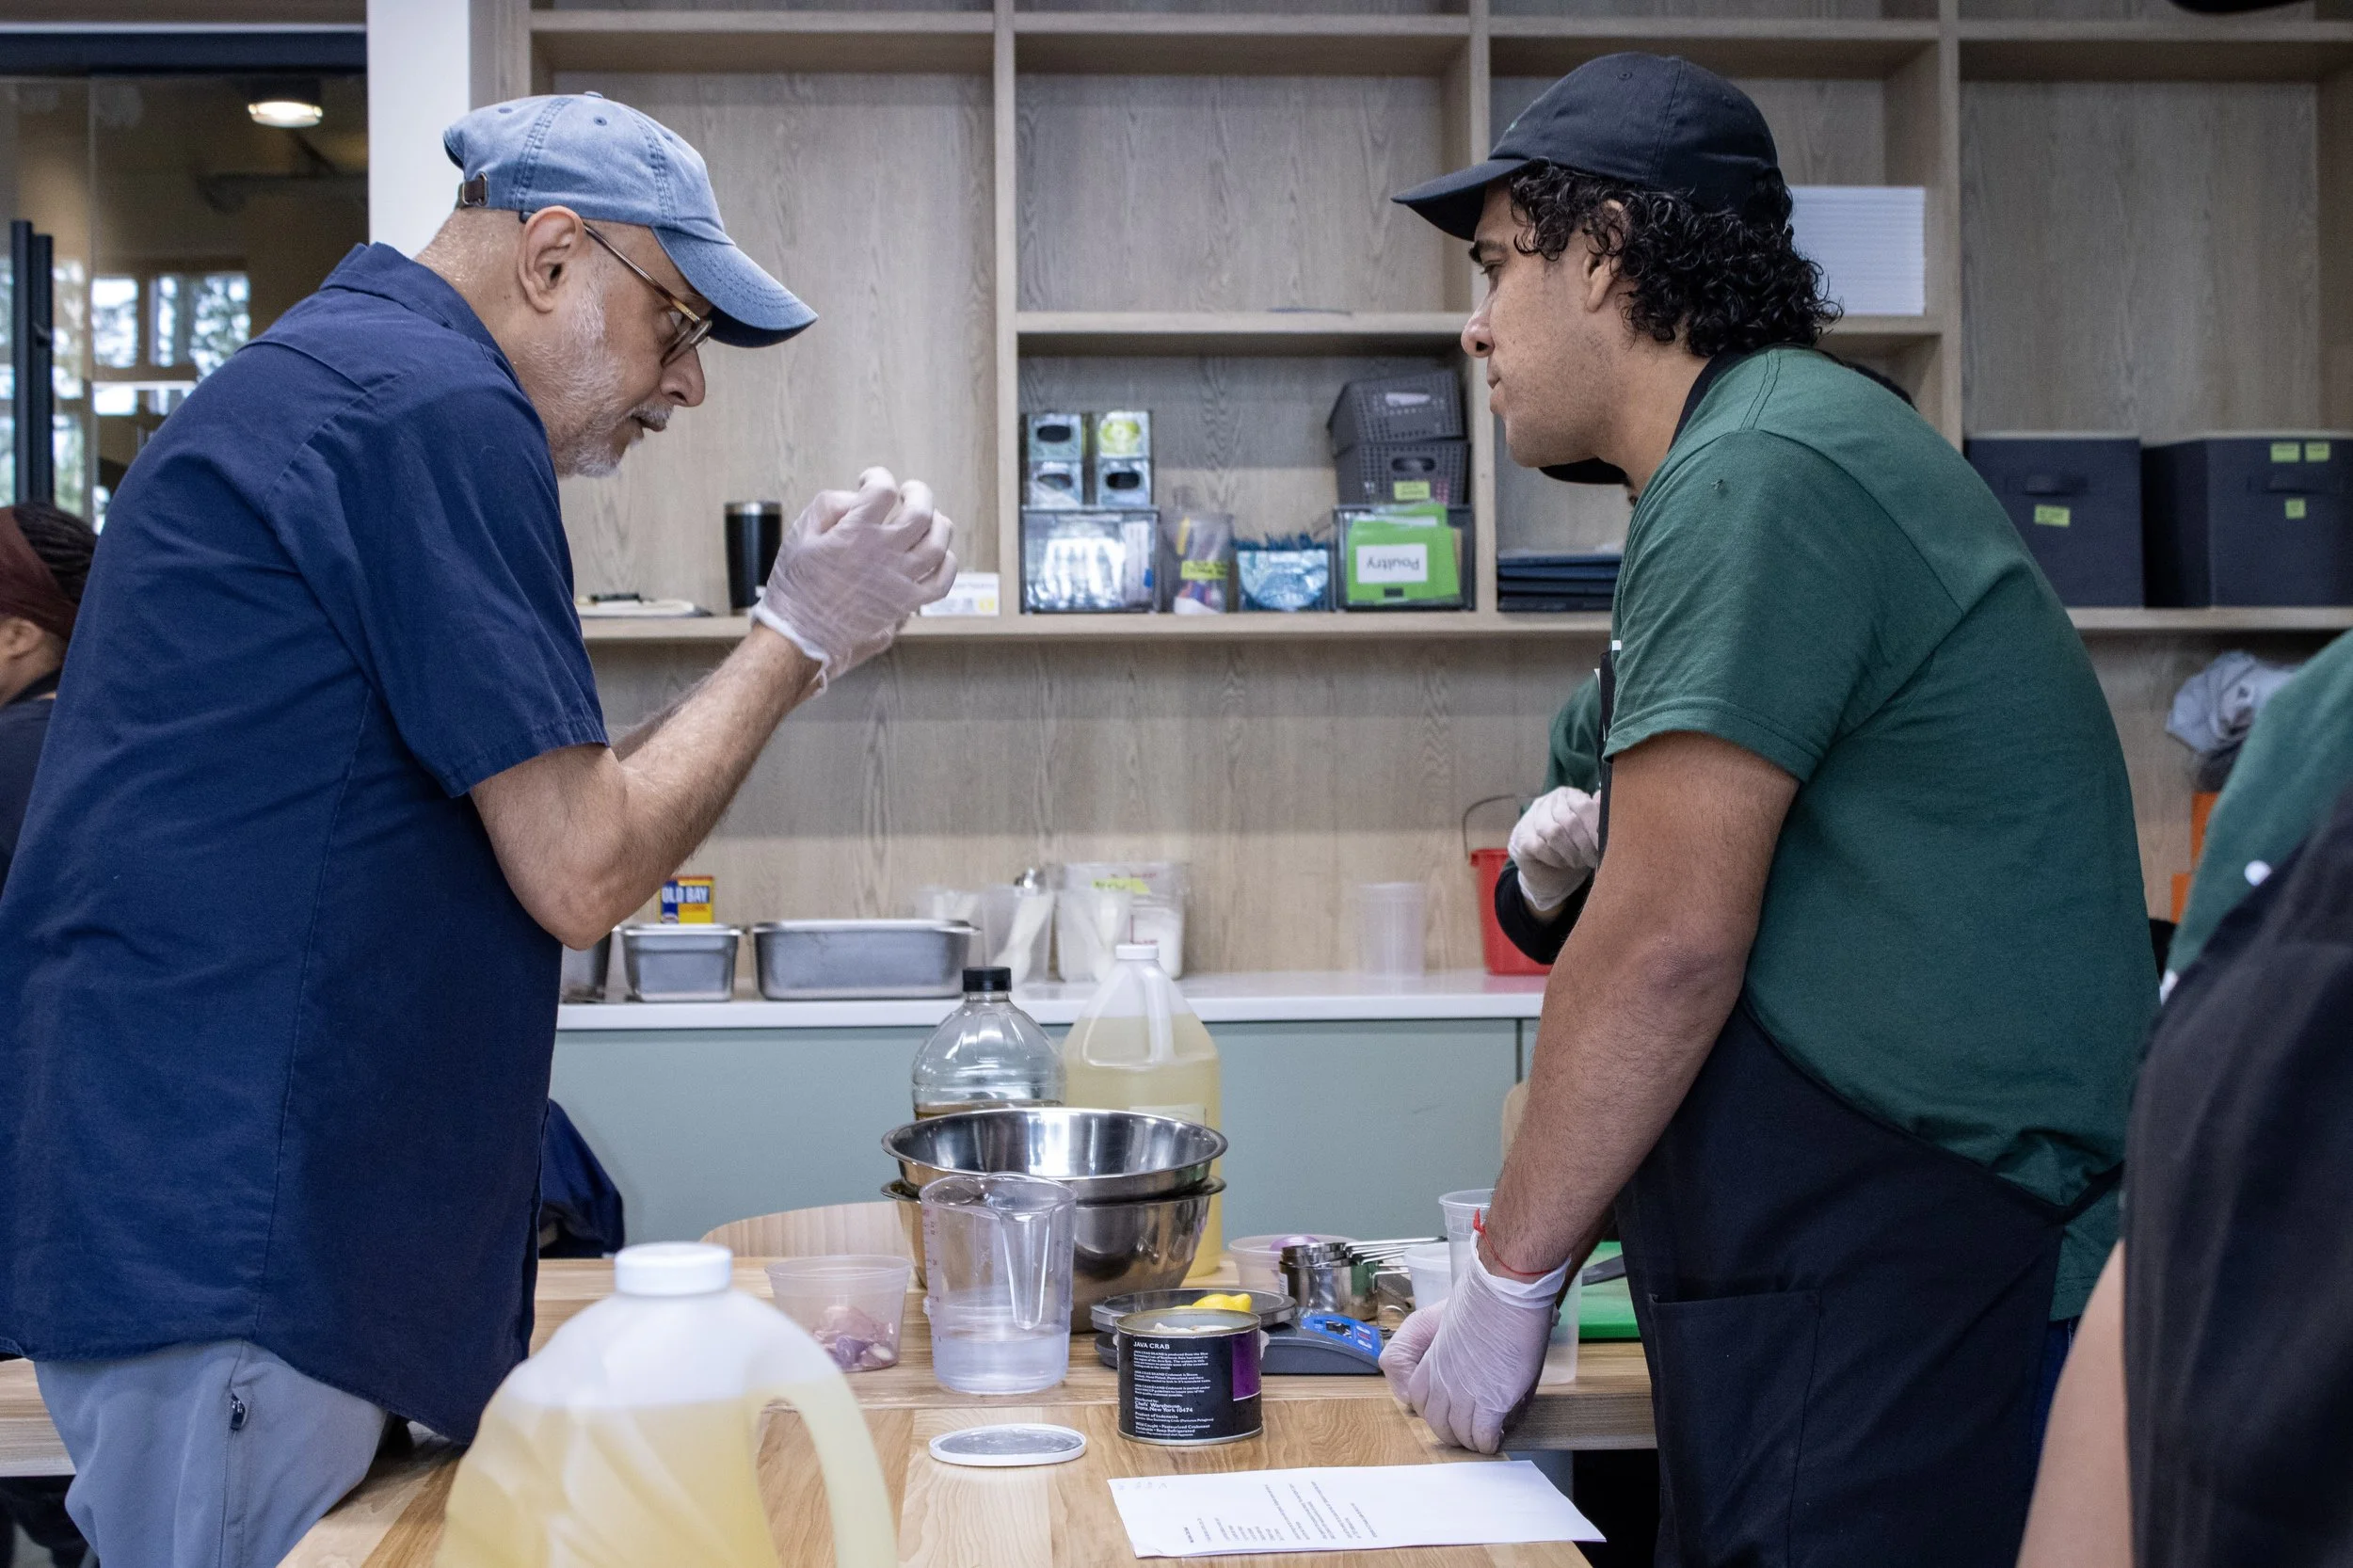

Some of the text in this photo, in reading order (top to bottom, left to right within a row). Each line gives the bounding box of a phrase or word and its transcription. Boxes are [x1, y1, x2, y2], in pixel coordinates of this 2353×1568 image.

[1366, 556, 1420, 571] Poultry
[662, 886, 709, 904] OLD BAY
